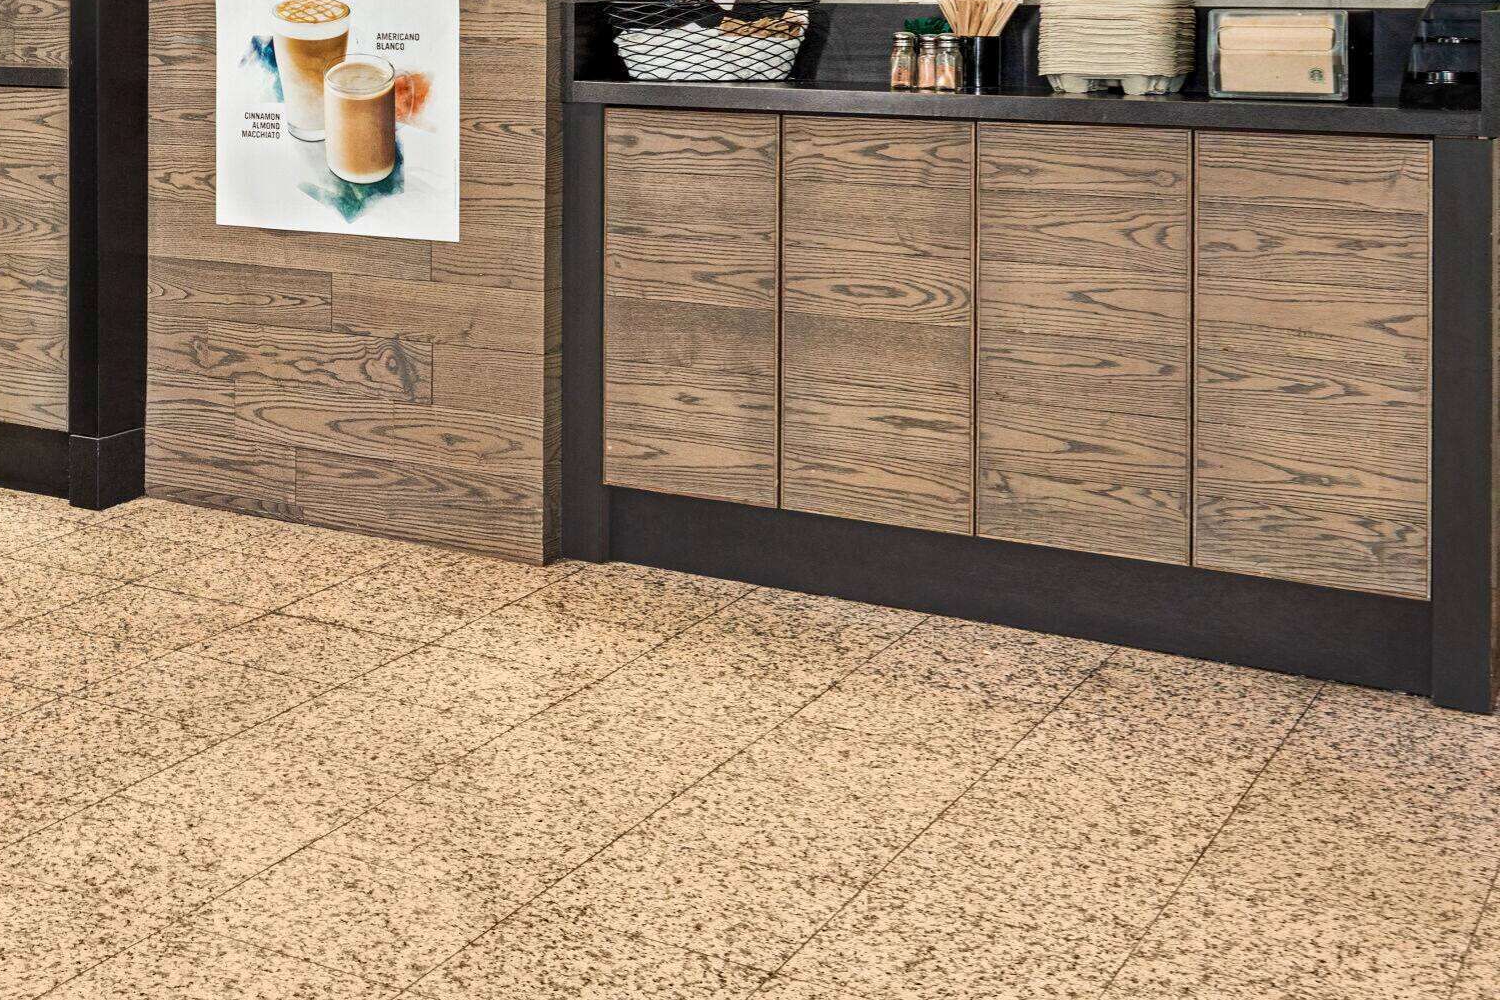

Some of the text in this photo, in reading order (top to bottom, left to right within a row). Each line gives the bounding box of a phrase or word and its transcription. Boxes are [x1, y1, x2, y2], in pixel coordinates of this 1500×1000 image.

[376, 32, 420, 41] AMERICANO
[376, 42, 405, 50] BLANCO
[244, 112, 281, 121] CINNAMON
[251, 121, 281, 130] ALMOND
[241, 130, 281, 139] MACCHIATO
